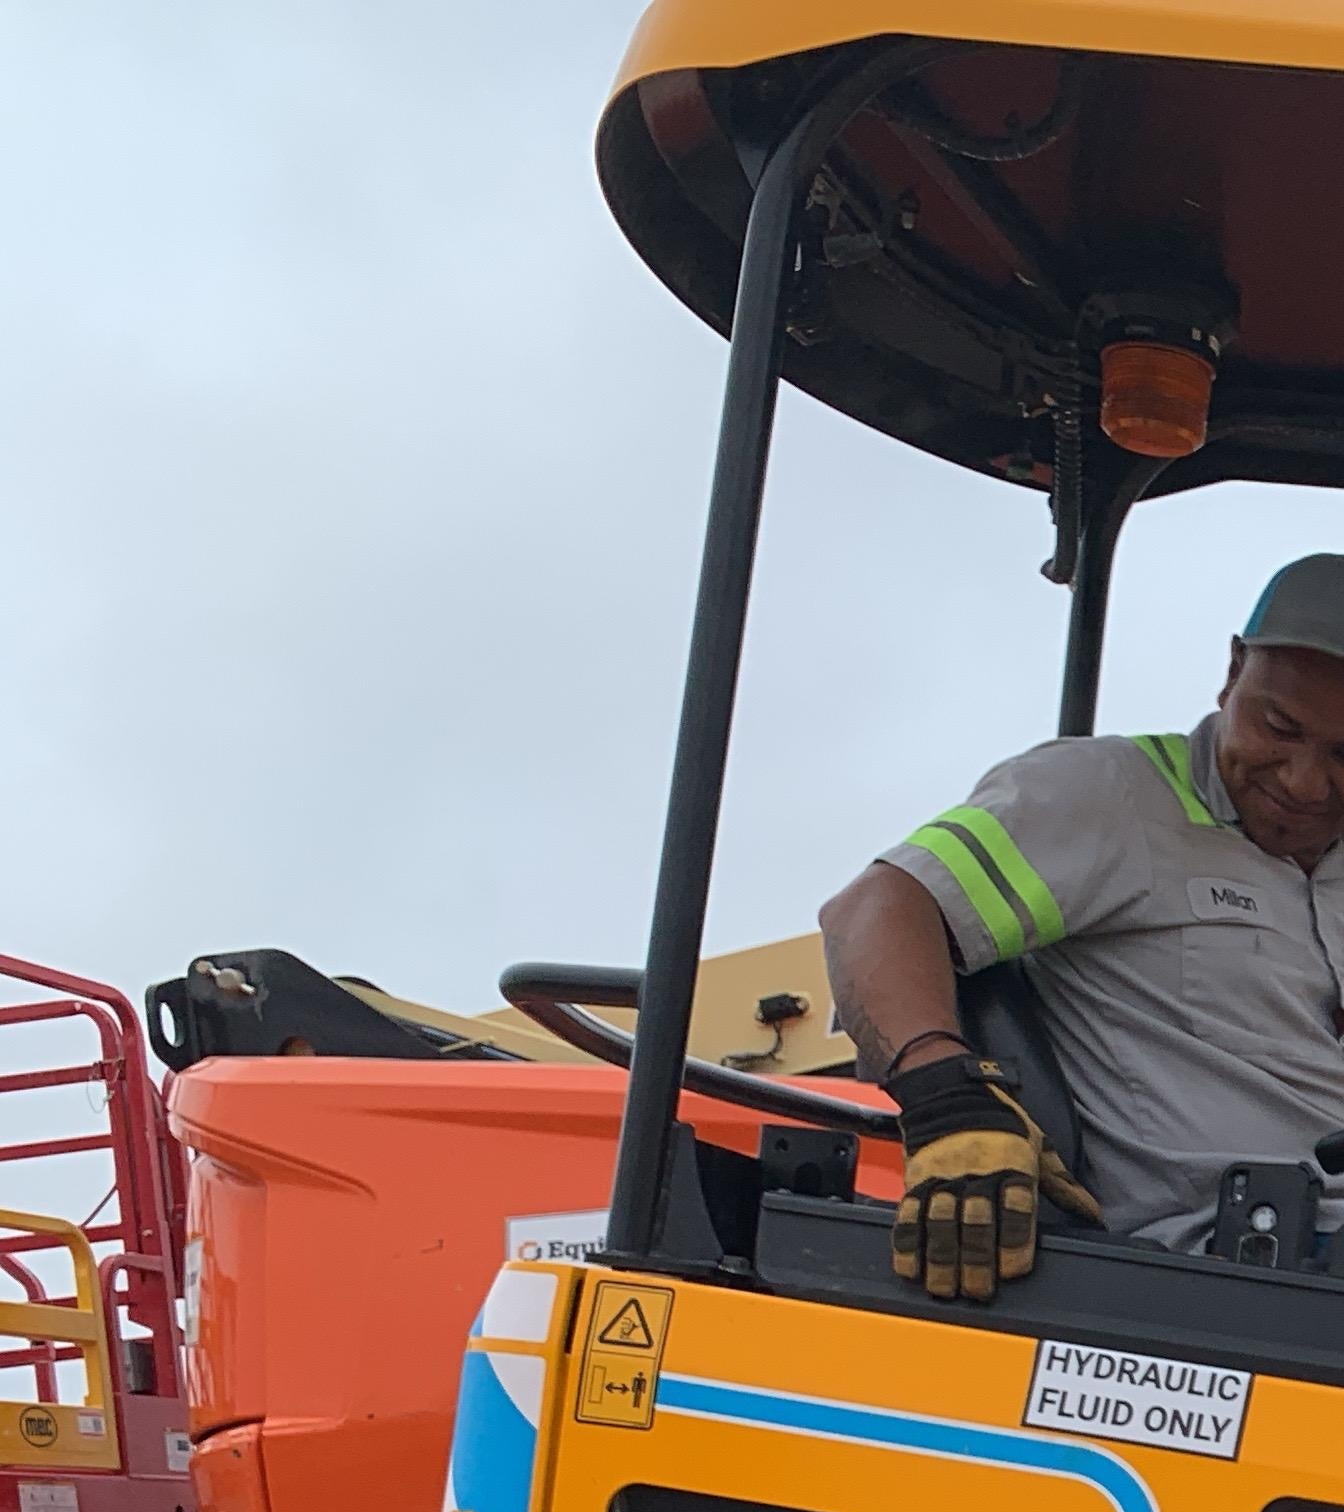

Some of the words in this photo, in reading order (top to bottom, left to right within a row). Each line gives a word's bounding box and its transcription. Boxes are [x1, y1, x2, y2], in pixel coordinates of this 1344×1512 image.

[1209, 886, 1258, 912] Milan
[1044, 1345, 1243, 1402] HYDRAULIC
[1037, 1388, 1135, 1428] FLUID
[1143, 1404, 1233, 1444] ONLY
